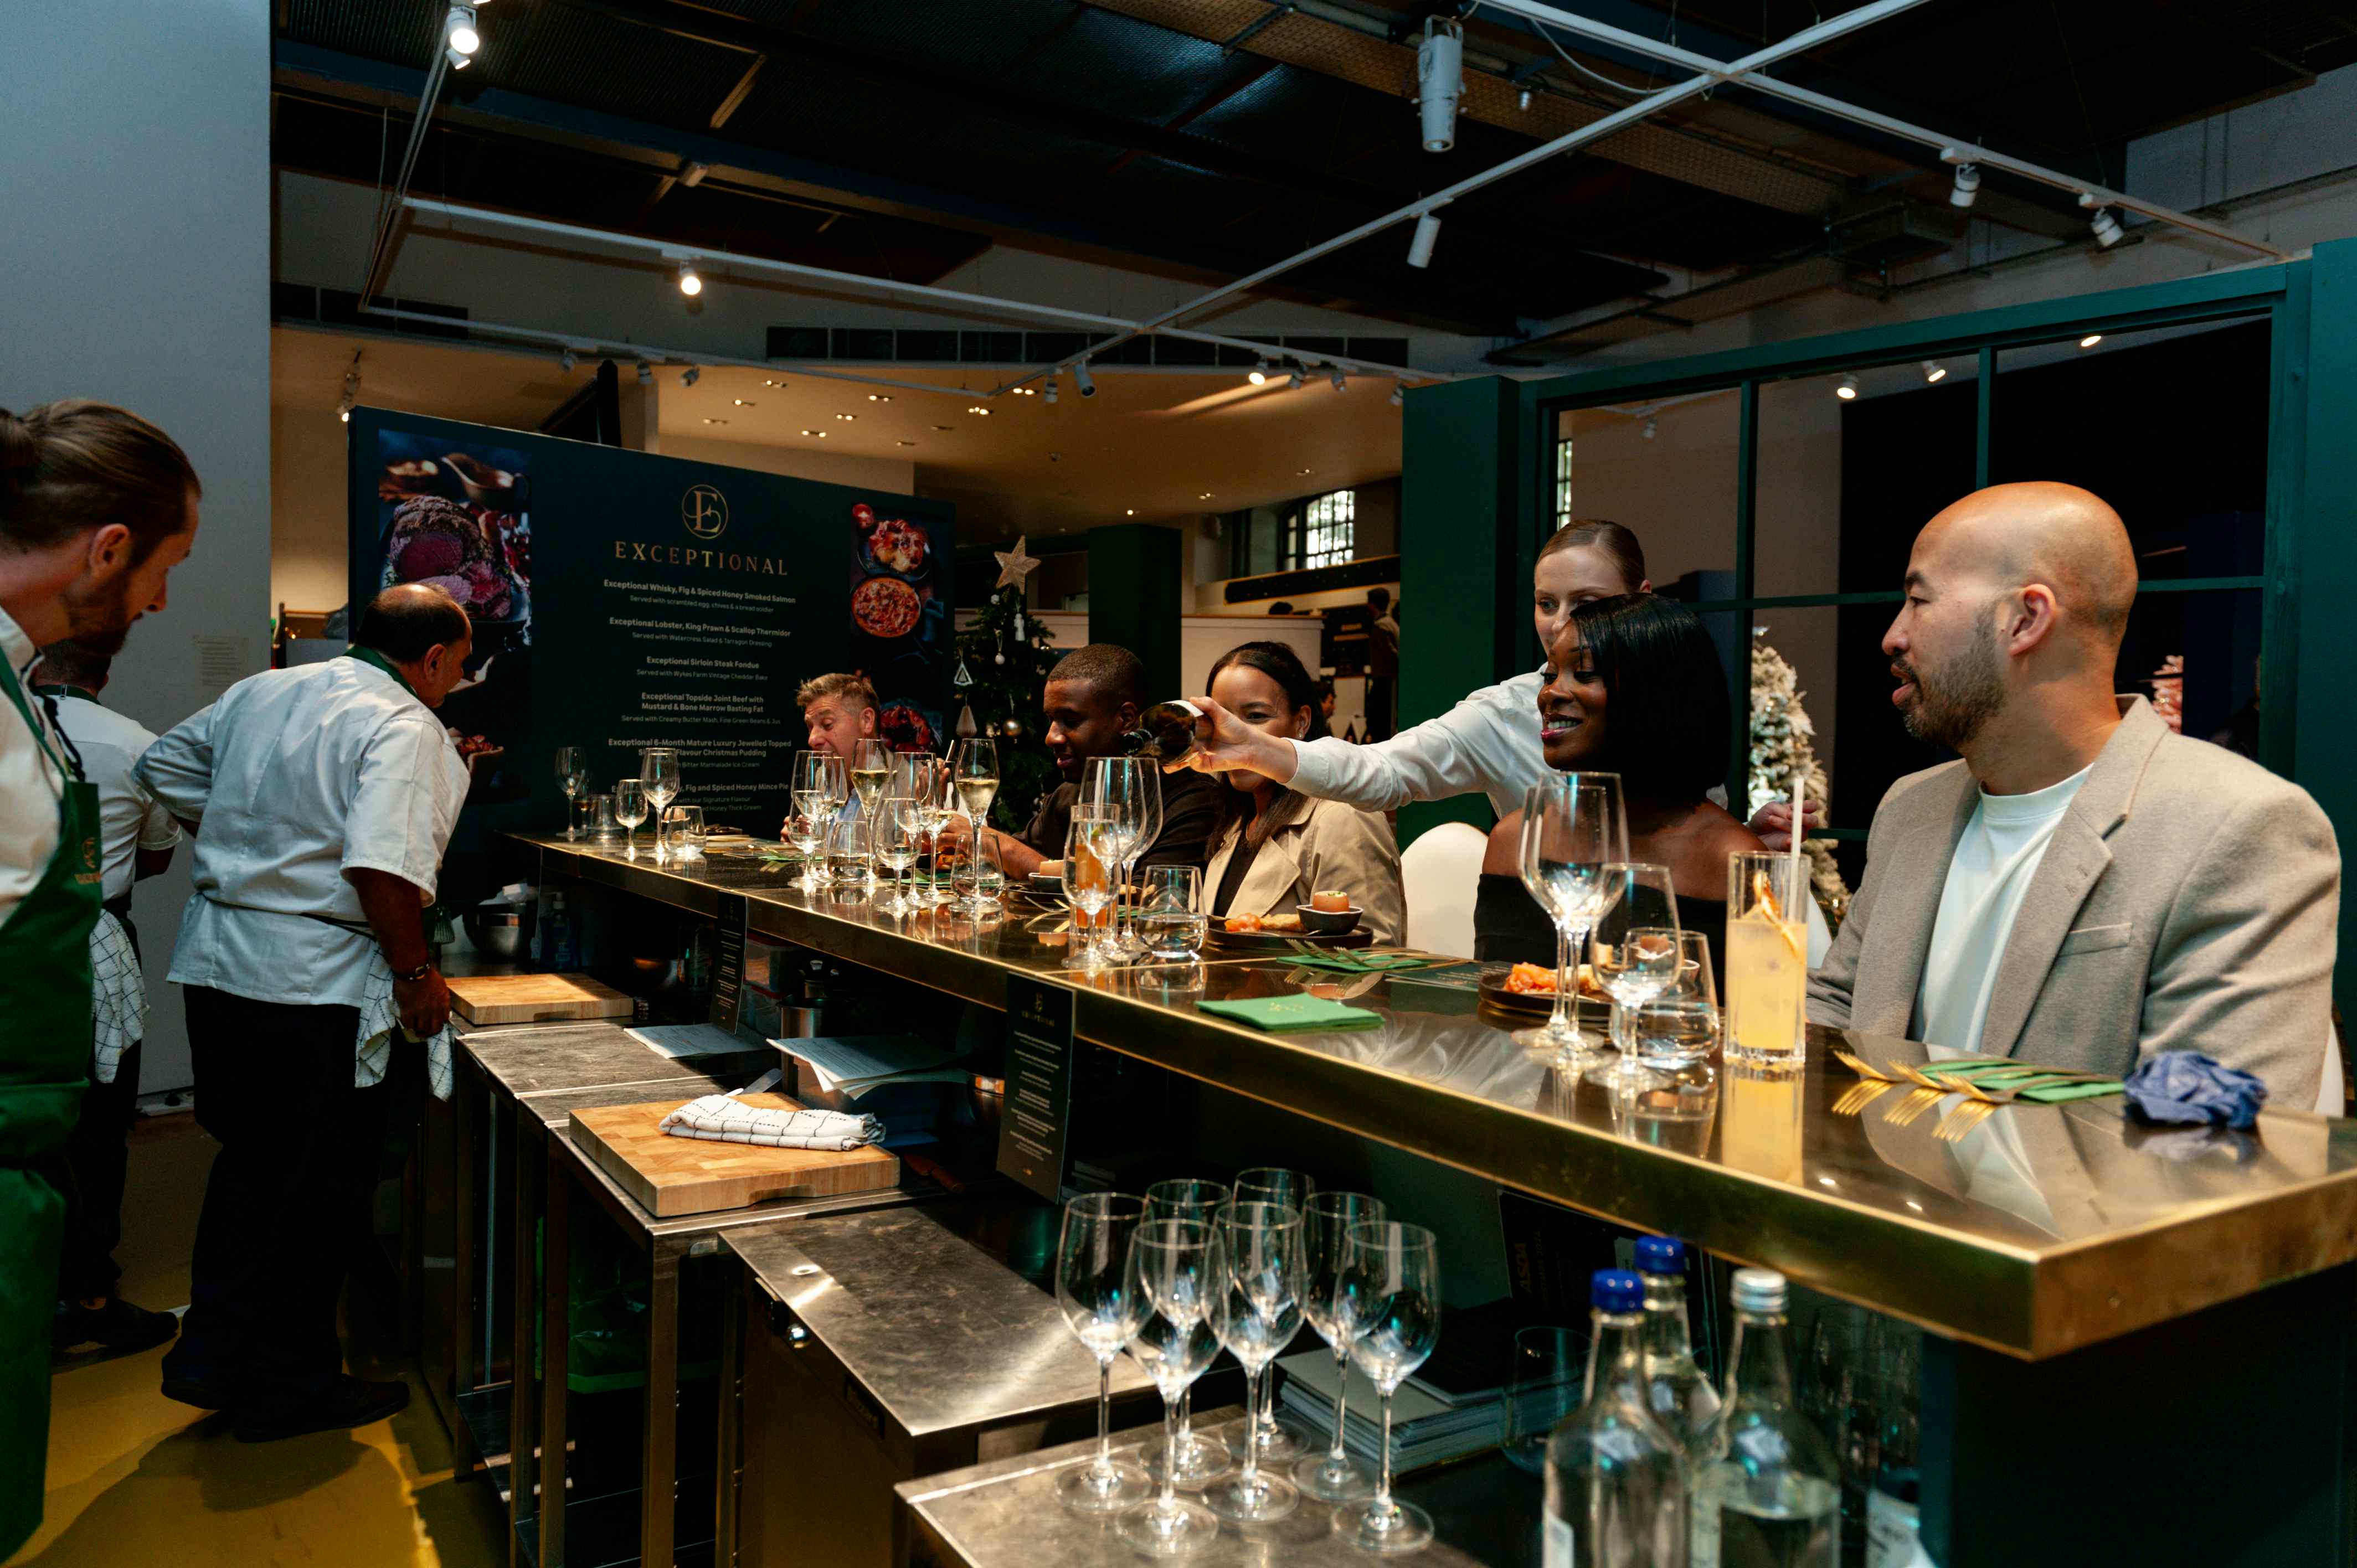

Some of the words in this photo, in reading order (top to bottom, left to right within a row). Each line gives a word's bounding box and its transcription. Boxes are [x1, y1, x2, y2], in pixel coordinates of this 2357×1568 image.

[615, 540, 788, 575] EXCEPTIONAL
[604, 579, 649, 590] Exceptional
[650, 583, 677, 594] Whisky,
[678, 586, 690, 595] Fig
[697, 588, 721, 596] Spiced
[722, 590, 744, 600] Honey
[745, 592, 771, 601] Smoked
[772, 595, 796, 604] Salmon
[610, 617, 653, 627] Exceptional
[655, 620, 685, 630] Lobster,
[686, 623, 701, 632] King
[702, 623, 724, 632] Prawn
[731, 626, 755, 635] Scallop
[756, 628, 791, 637] Thermidor
[669, 634, 701, 642] Watercress
[749, 639, 772, 648] Dressing
[646, 656, 689, 666] Exceptional
[642, 692, 684, 701] Exceptional
[727, 705, 752, 714] Basting
[609, 738, 653, 747] Exceptional
[768, 740, 791, 748] Topped
[686, 785, 696, 793] Fig
